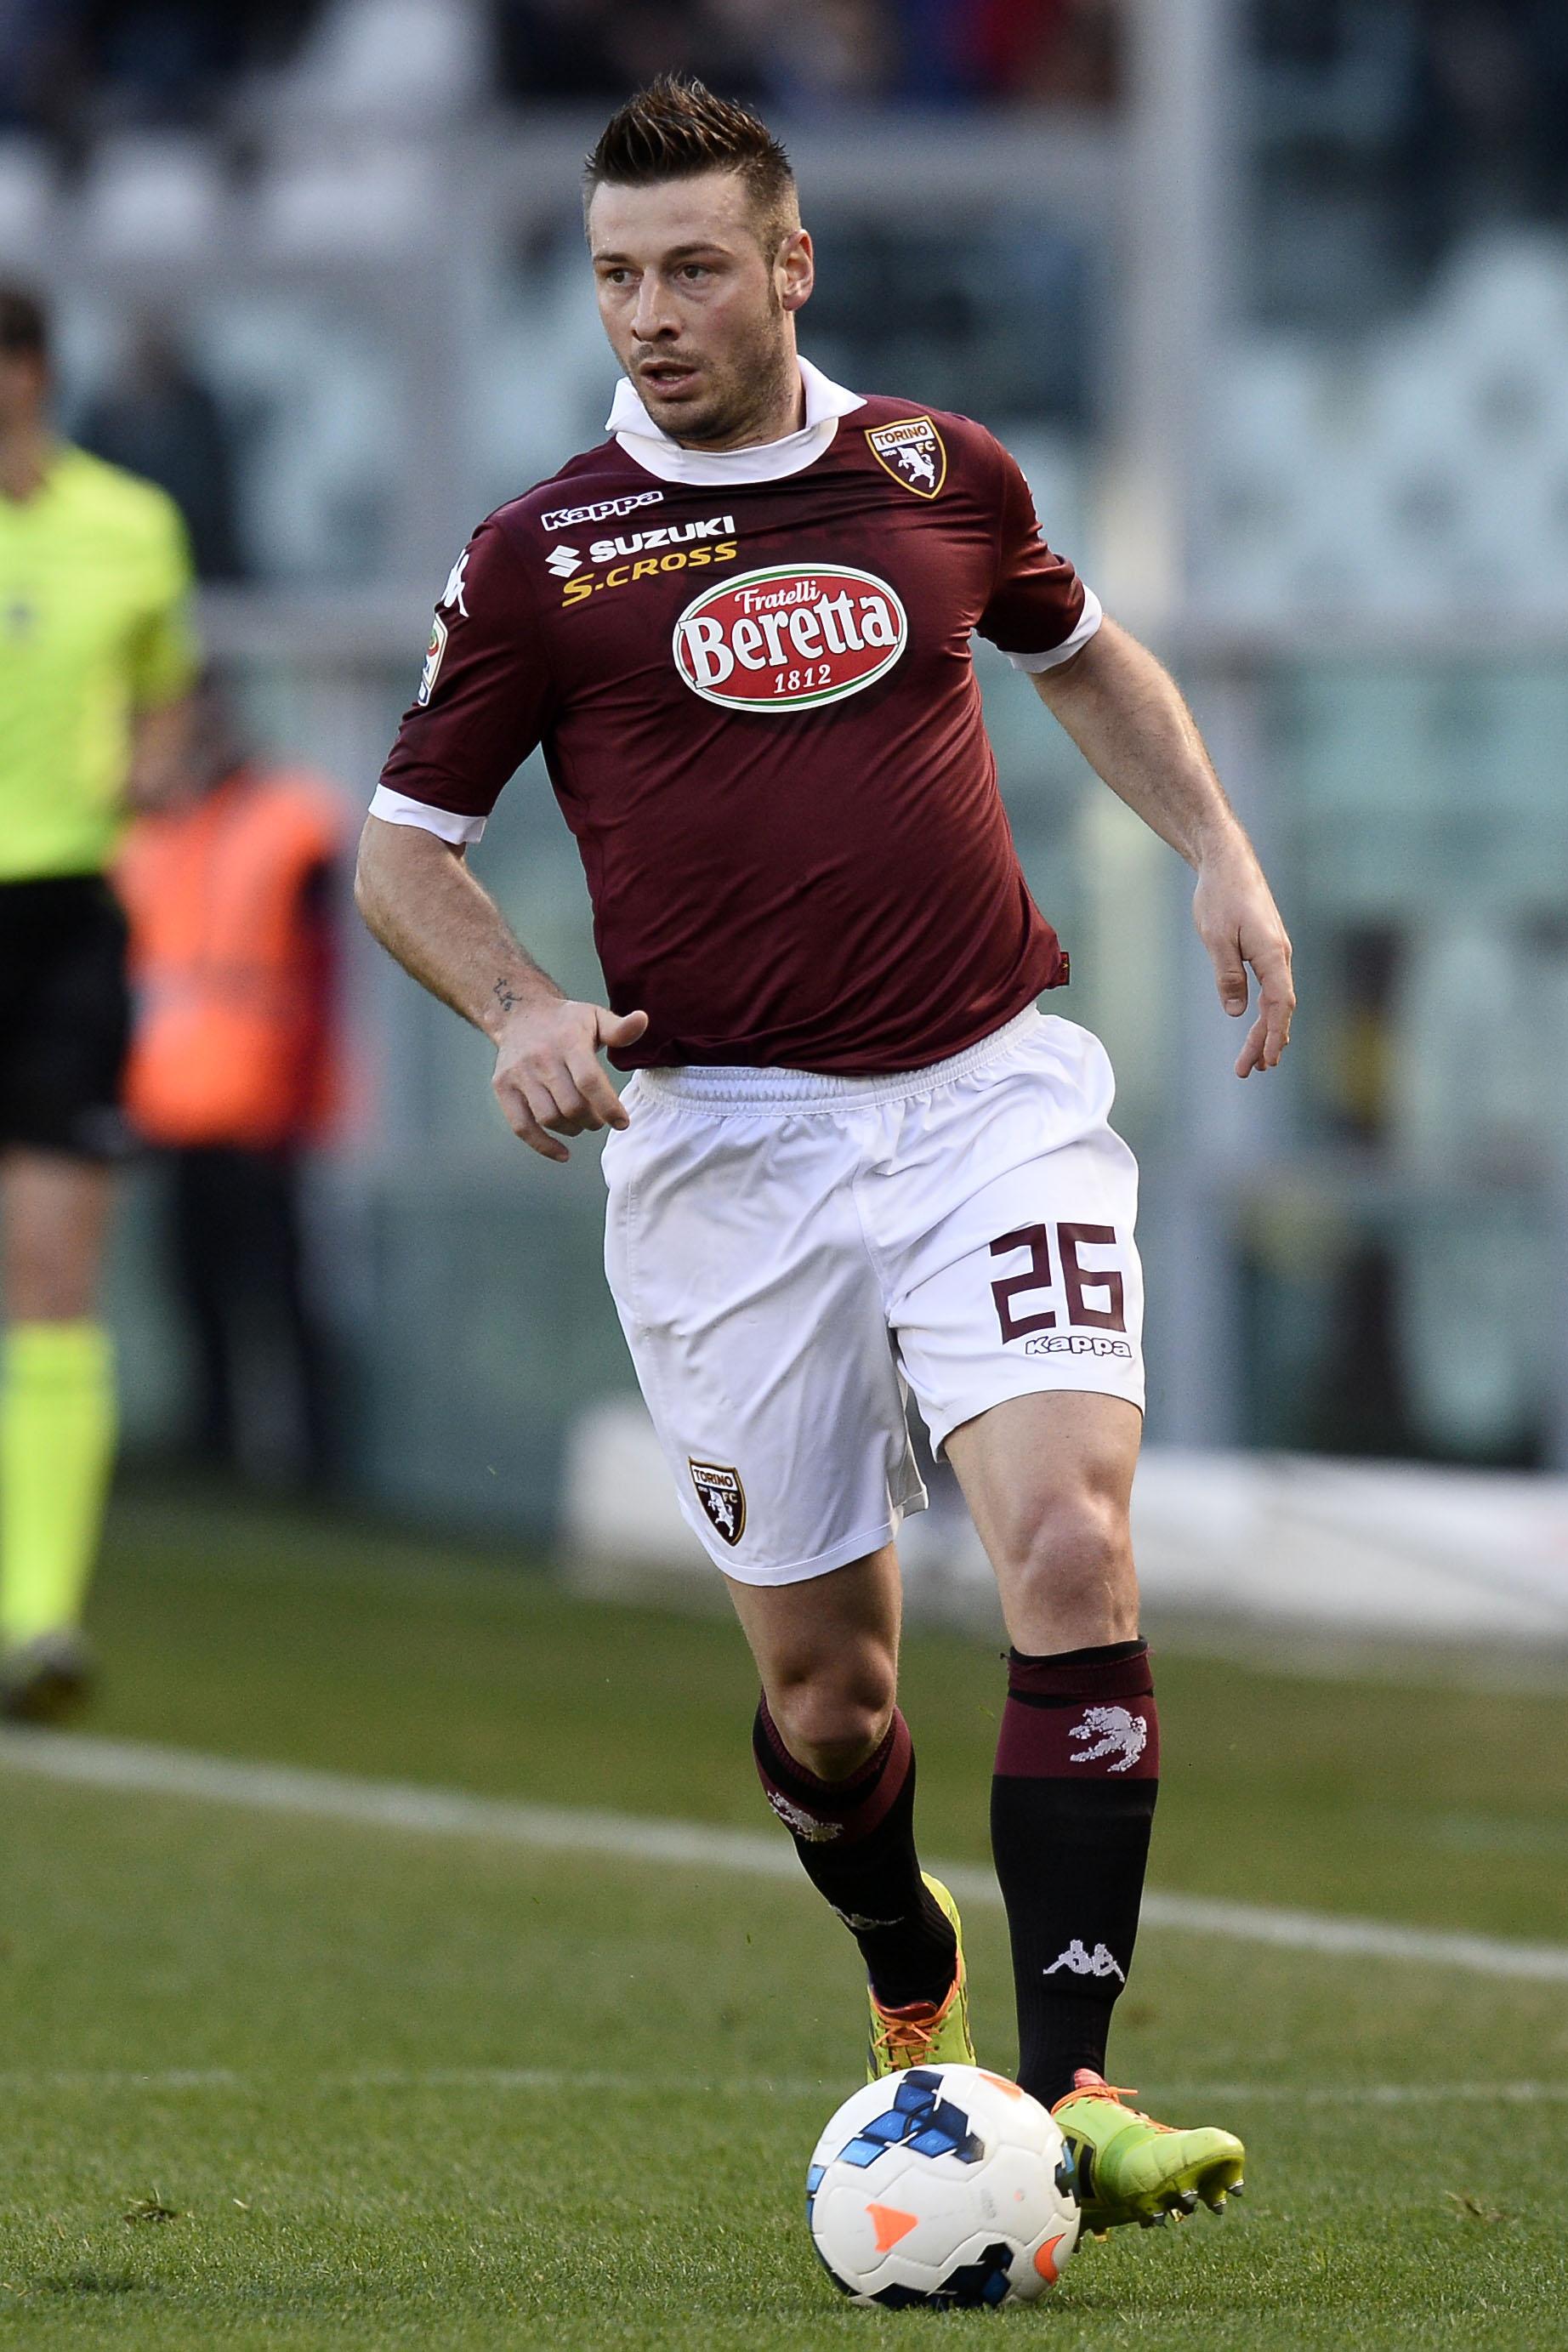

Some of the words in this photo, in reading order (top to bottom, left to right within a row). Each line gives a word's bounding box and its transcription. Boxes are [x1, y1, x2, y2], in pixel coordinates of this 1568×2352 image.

[874, 425, 928, 446] TORINO
[915, 440, 936, 454] FC
[541, 491, 664, 531] Kappa
[589, 515, 736, 563] SUZUKI
[734, 581, 821, 615] Fratelli
[679, 590, 900, 690] Beretta
[773, 663, 832, 694] 1812
[989, 1222, 1128, 1345] 26
[1025, 1336, 1133, 1358] Kappa
[693, 1469, 734, 1488] TORINO
[722, 1491, 738, 1503] FC
